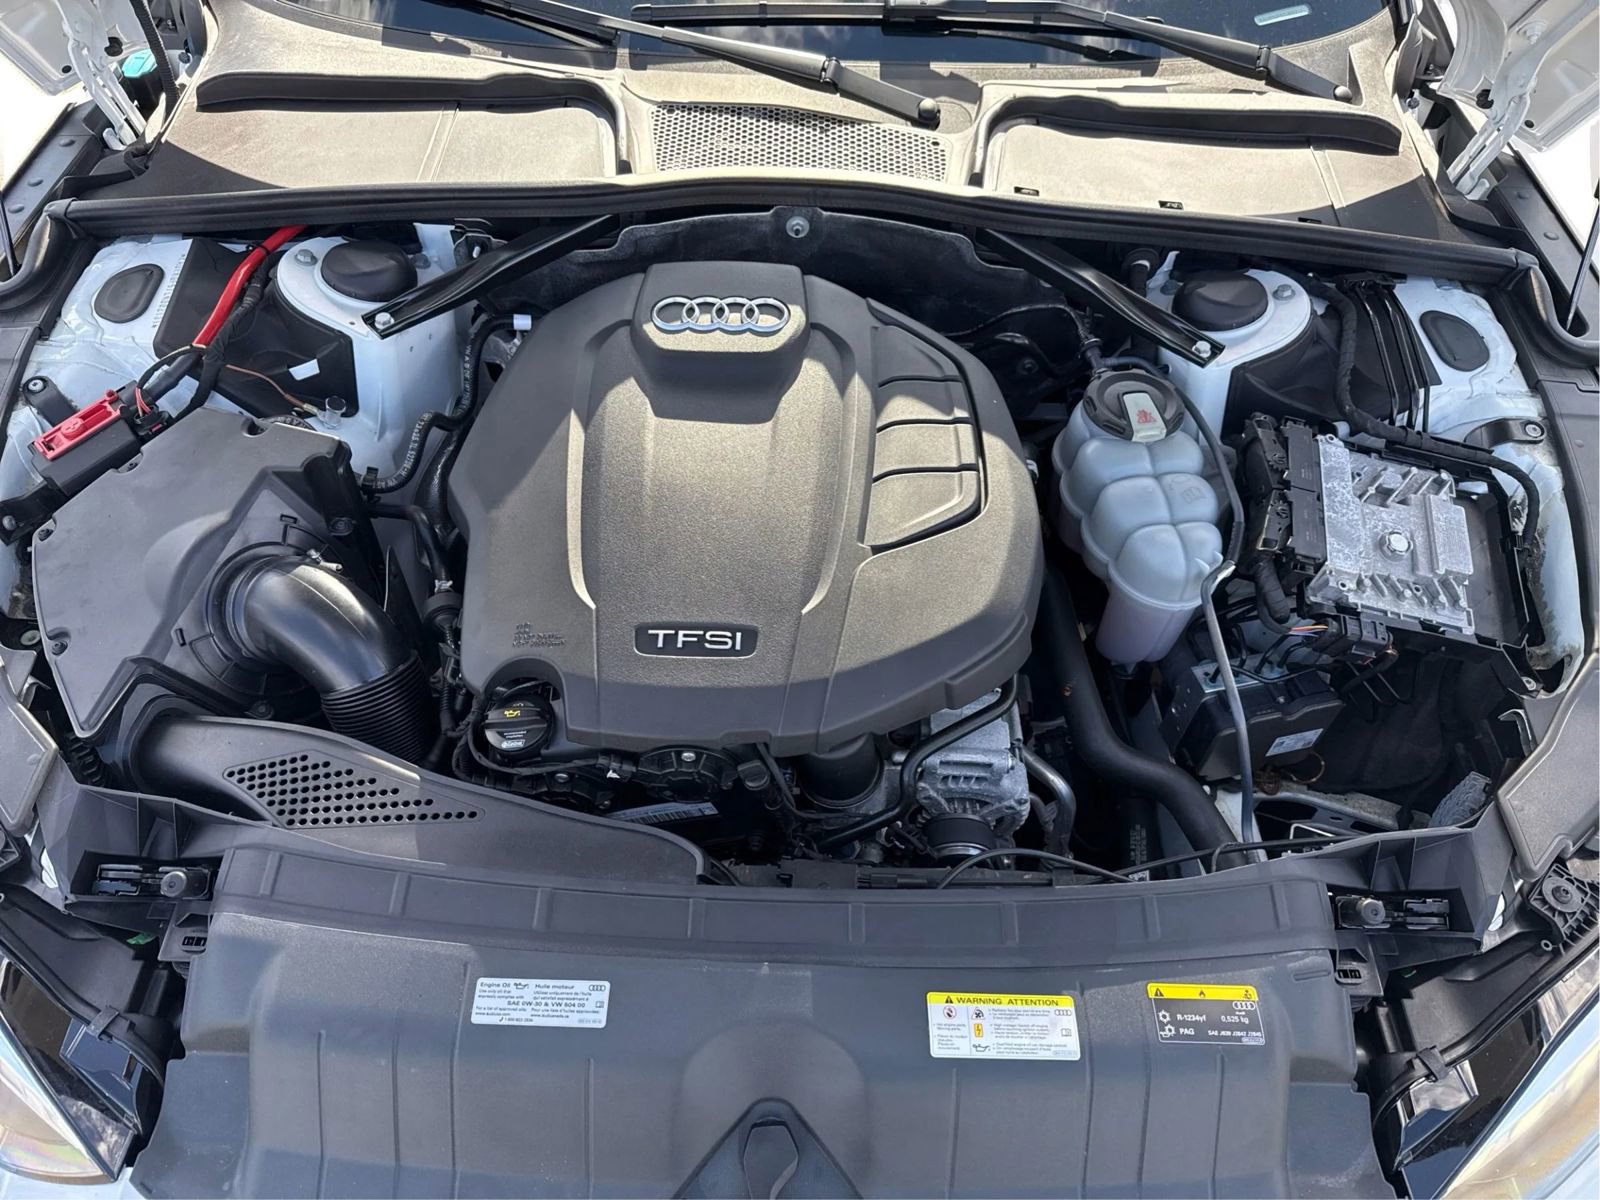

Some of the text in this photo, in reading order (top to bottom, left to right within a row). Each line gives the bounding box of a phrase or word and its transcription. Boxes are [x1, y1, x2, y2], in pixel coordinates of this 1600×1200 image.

[648, 630, 742, 650] TFSI
[1176, 1014, 1207, 1023] R-1234yf
[1240, 1015, 1249, 1024] kg
